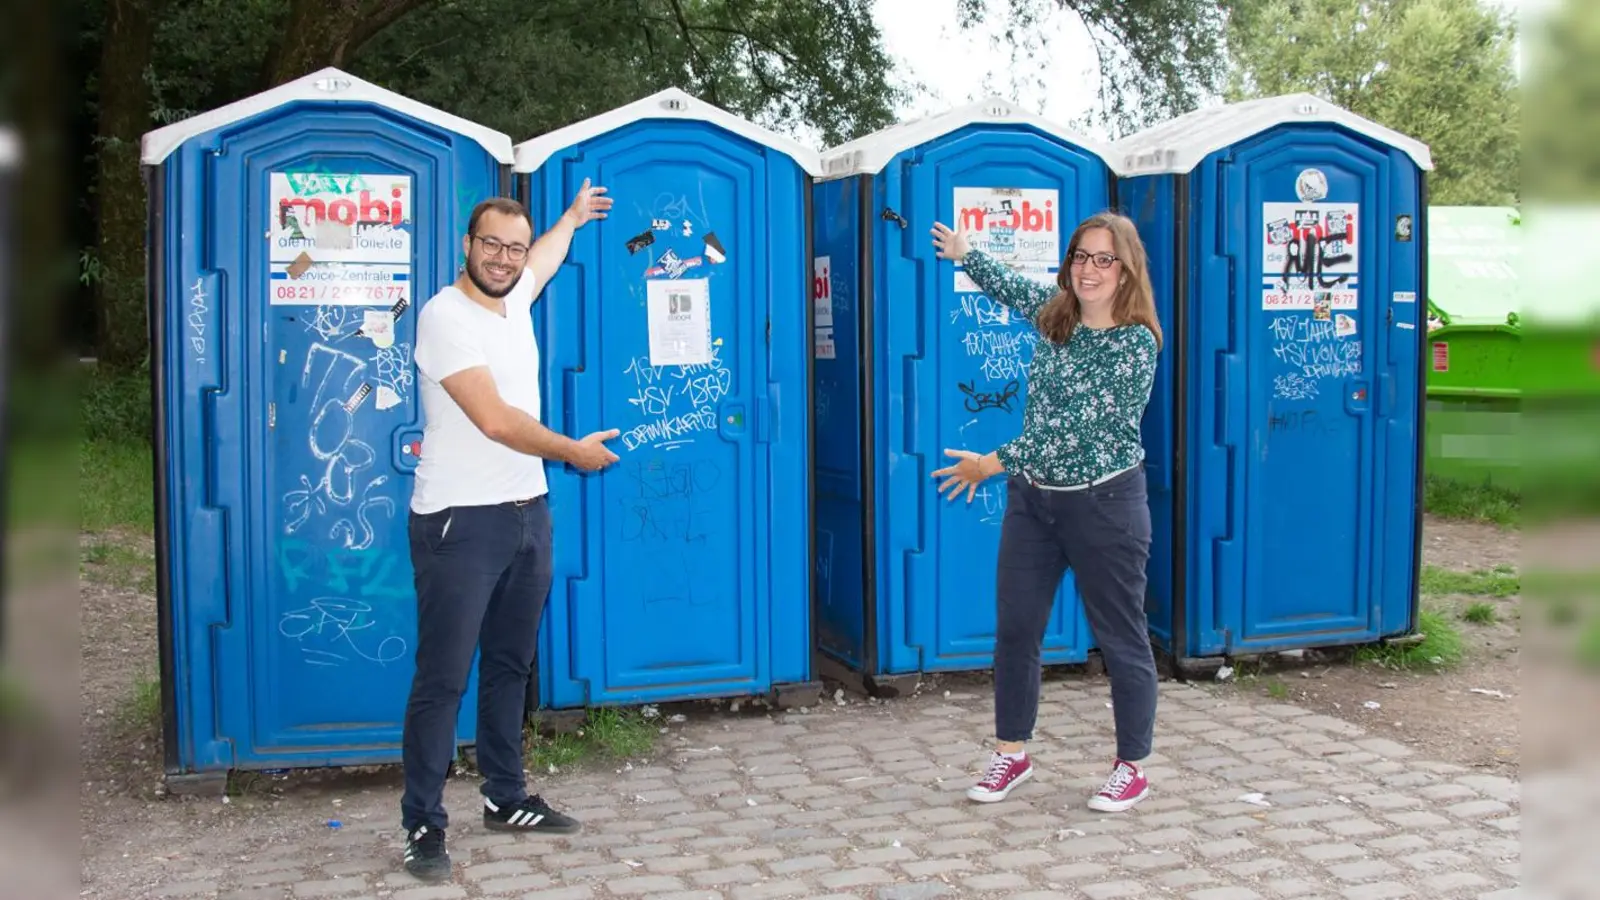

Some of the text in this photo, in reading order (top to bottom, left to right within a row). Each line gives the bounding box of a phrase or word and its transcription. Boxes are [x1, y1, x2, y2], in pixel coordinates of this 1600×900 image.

[279, 190, 402, 227] mobi
[299, 269, 391, 281] ervice-Zentrale
[1296, 317, 1345, 343] JAHR
